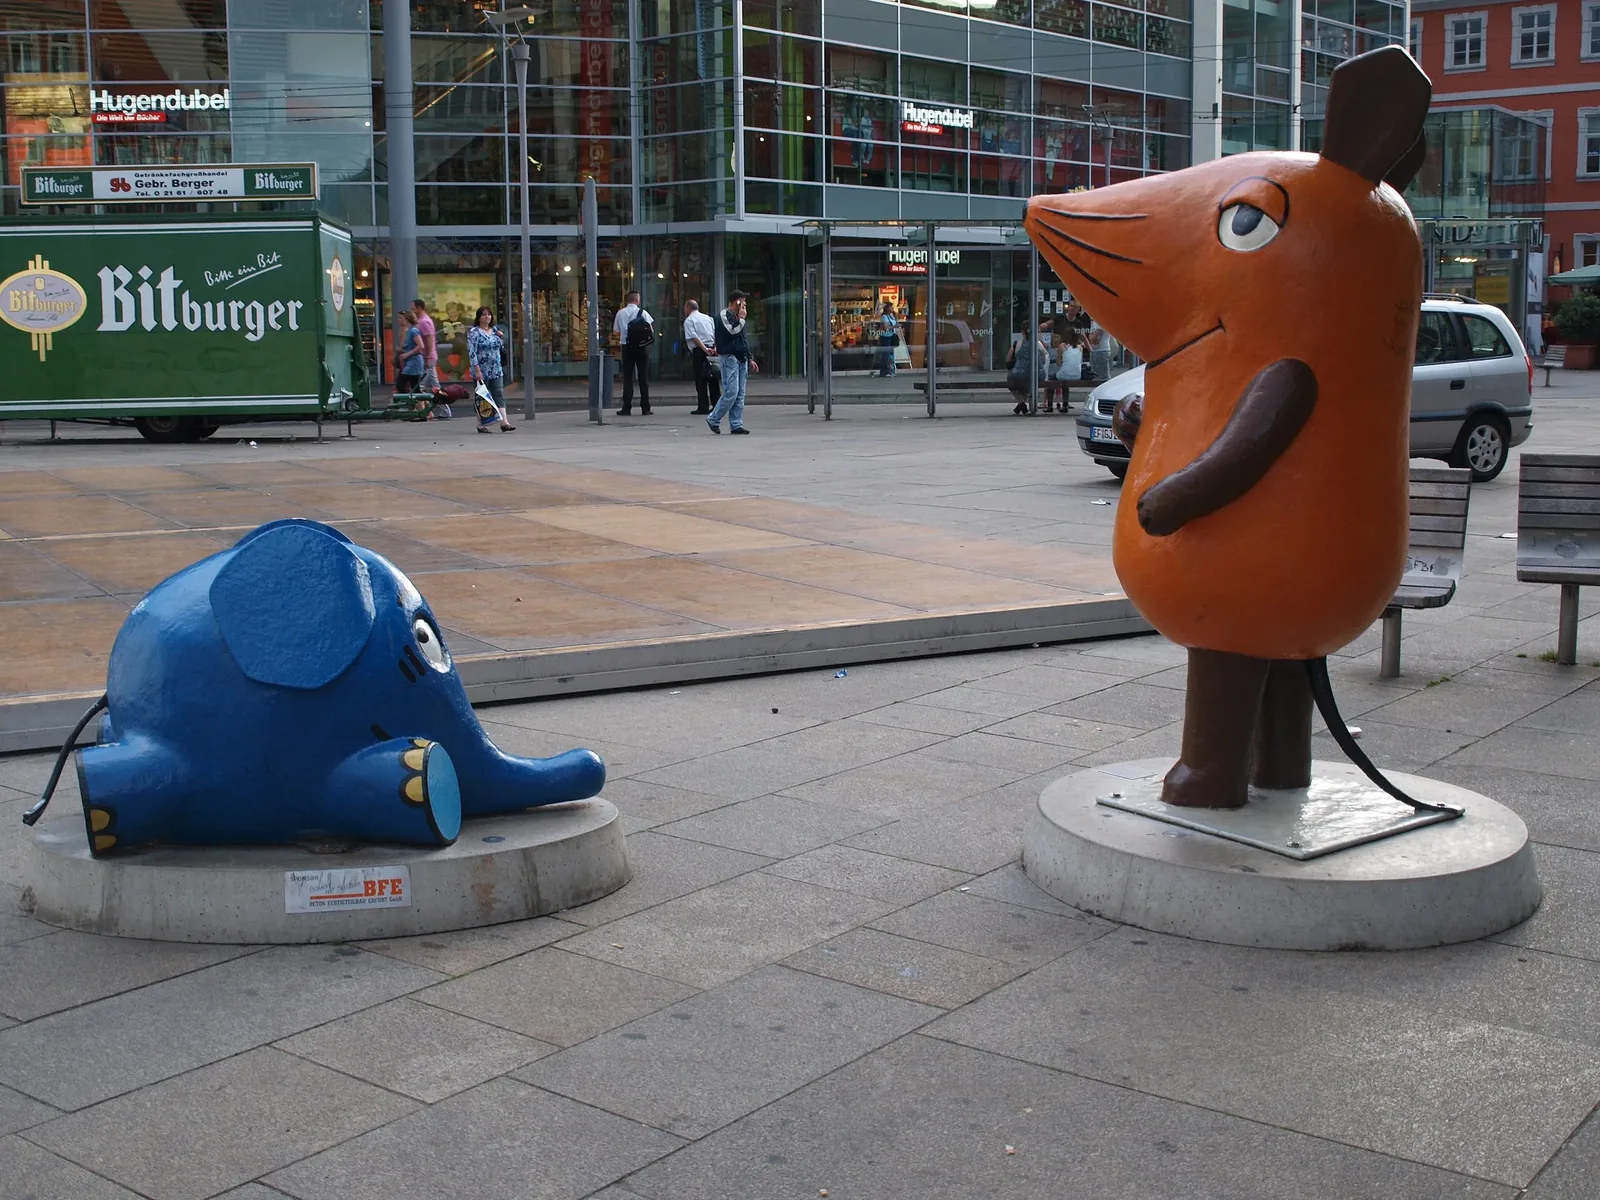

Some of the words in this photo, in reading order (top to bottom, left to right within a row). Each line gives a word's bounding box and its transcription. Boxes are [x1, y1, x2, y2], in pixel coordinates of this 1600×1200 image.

[90, 89, 229, 115] Hugendubel
[903, 102, 973, 128] Hugendubel
[35, 176, 83, 195] Bitburger
[135, 179, 167, 188] Gebr.
[171, 179, 214, 189] Berger
[255, 172, 303, 191] Bitburger
[205, 270, 234, 286] Bitte
[238, 265, 256, 275] ein
[257, 251, 281, 267] Bit
[9, 289, 77, 315] Bitburger
[97, 264, 303, 342] Bitburger
[364, 879, 402, 896] BFE
